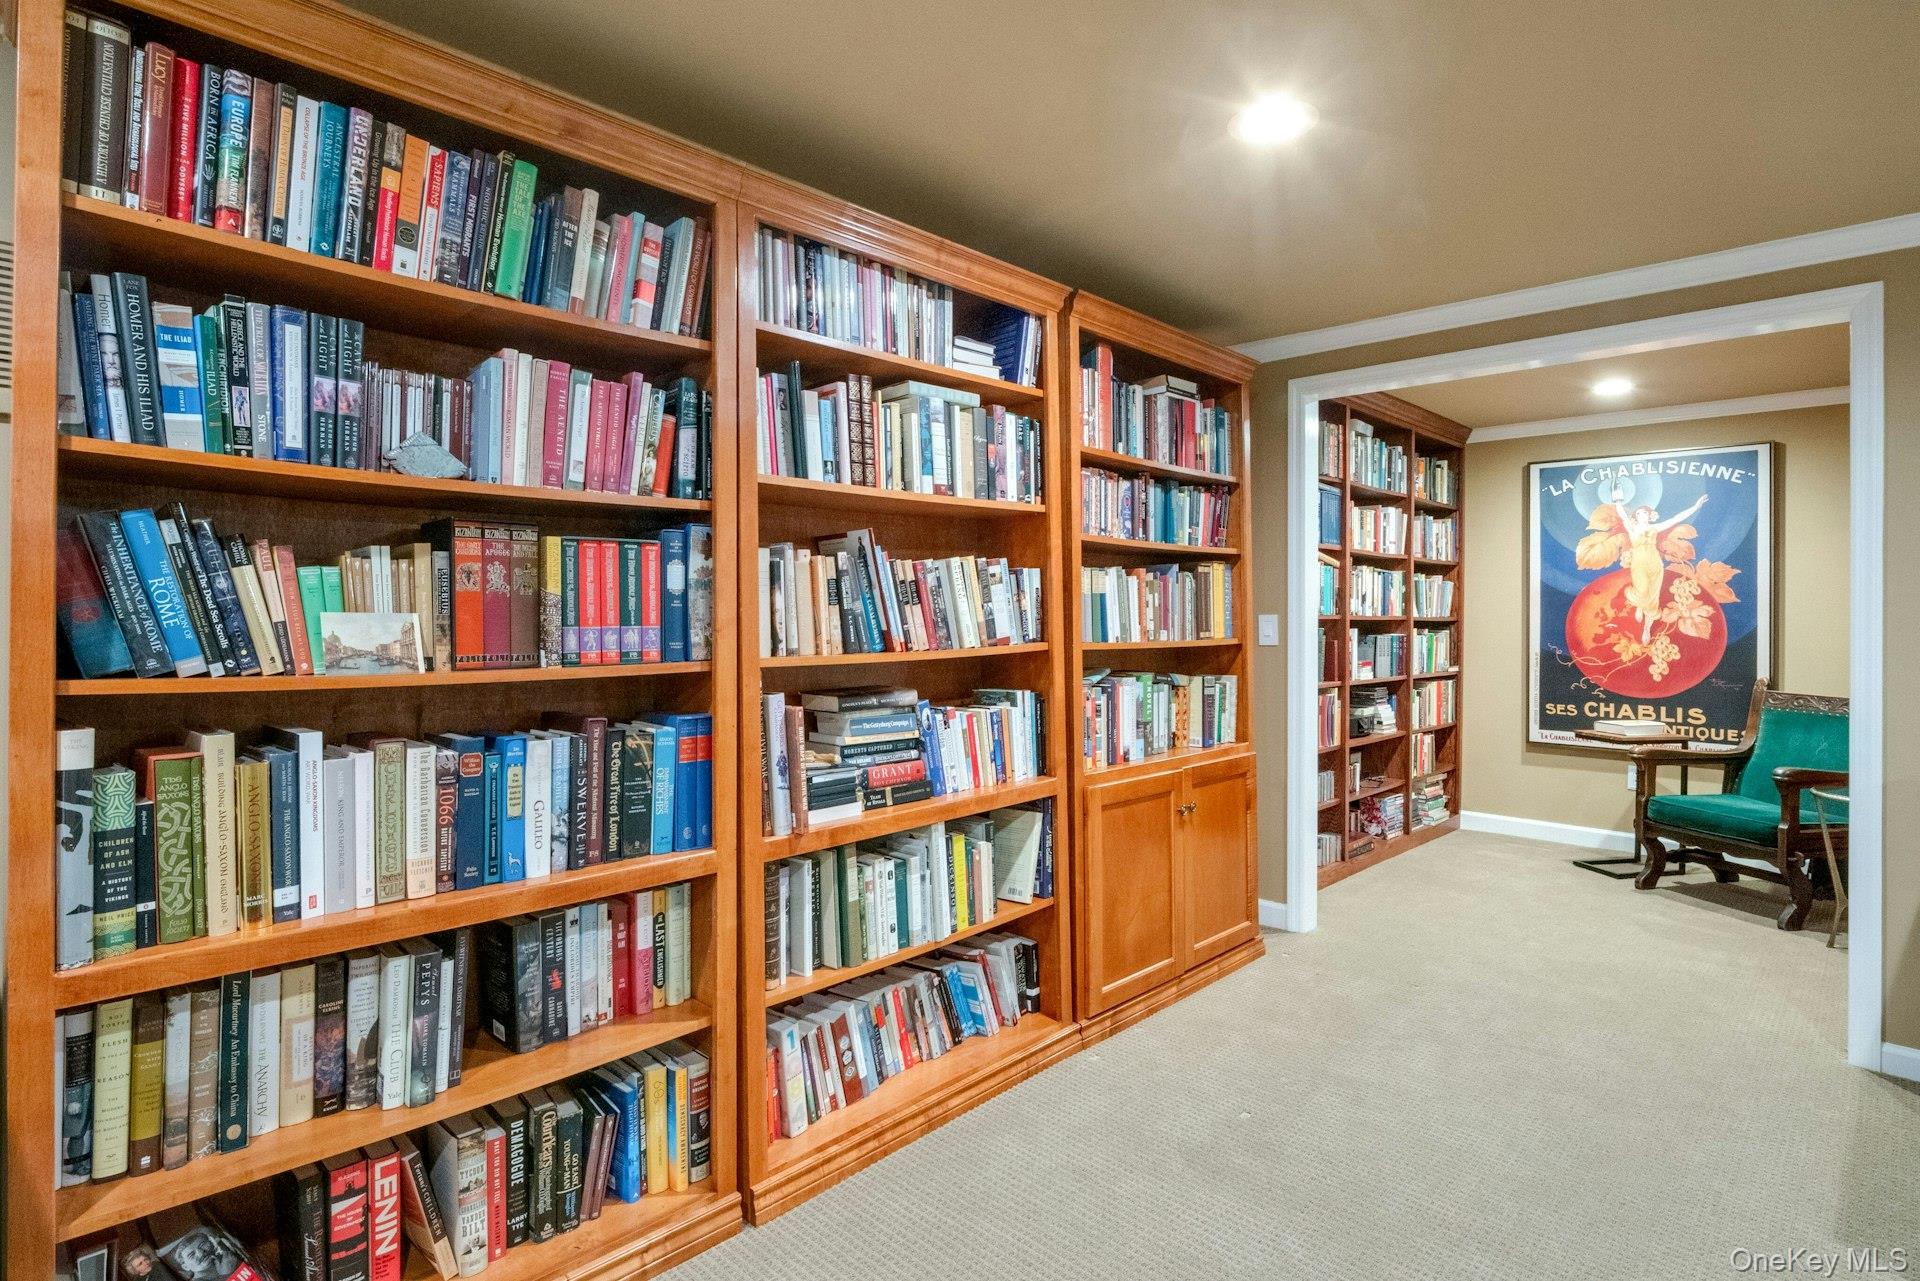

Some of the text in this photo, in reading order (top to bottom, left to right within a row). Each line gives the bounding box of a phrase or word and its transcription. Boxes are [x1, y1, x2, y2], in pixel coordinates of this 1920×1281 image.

[101, 42, 114, 95] CIVILISATION
[99, 96, 111, 130] CHINESE
[205, 72, 221, 161] BORN IN AFRICA
[229, 100, 244, 148] EUROPE
[303, 107, 311, 132] COLLAPSE
[100, 130, 109, 141] OF
[180, 124, 189, 155] MILLION
[322, 119, 343, 177] ANCESTRAL JOURNEYS
[97, 143, 109, 177] HISTORY
[370, 158, 379, 167] Up
[228, 168, 239, 206] FLANNERY
[370, 175, 378, 186] the
[430, 162, 443, 207] SAPIENS
[366, 198, 375, 211] Age
[462, 194, 477, 257] FIRST MIGRANTS
[490, 212, 505, 271] Human Evolution
[97, 293, 112, 329] Homer
[160, 334, 192, 343] THE ILIAD
[319, 334, 328, 371] LIGHT
[127, 294, 154, 431] HOMER AND HIS ILIAD
[342, 339, 352, 375] LIGHT
[94, 382, 102, 397] SEA
[206, 370, 216, 396] ILIAD
[257, 414, 266, 443] STONE
[343, 420, 351, 451] HERMAN
[555, 388, 566, 456] THE AENEID
[648, 393, 663, 442] CATULLUS
[231, 541, 241, 564] CAHILL
[259, 541, 272, 571] PAUL
[108, 585, 125, 619] WICKHAM
[113, 535, 163, 653] INHERITANCE ROME
[148, 578, 180, 629] ROME
[159, 560, 193, 640] THE RESTORATION OF
[441, 568, 449, 614] EUSEBIUS
[198, 572, 228, 649] The Dead Sea Scrolls
[1545, 701, 1708, 725] SES CHABLIS
[872, 764, 912, 779] GRANT
[439, 786, 455, 825] 1066
[609, 741, 622, 852] The Great Fire of London
[656, 767, 665, 815] OF RICHES
[533, 800, 544, 849] GALILEO
[577, 777, 587, 842] SWERVE
[98, 837, 134, 848] CHILDREN
[104, 849, 130, 858] OF ASH
[284, 824, 292, 869] ANGLO-SAXON
[100, 859, 133, 871] AND ELM
[656, 923, 665, 948] LAST
[232, 980, 241, 997] Lord
[421, 962, 431, 1006] PEPYS
[229, 998, 241, 1036] Macartney
[102, 1038, 128, 1048] FLESH
[230, 1039, 238, 1049] An
[390, 1021, 402, 1083] THE CLUB
[229, 1051, 239, 1084] Embassy
[230, 1094, 238, 1117] China
[255, 1064, 269, 1117] ANARCHY
[510, 1119, 524, 1187] DEMAGOGUE
[572, 1154, 579, 1165] GO
[375, 1157, 398, 1257] LENIN
[424, 1193, 442, 1236] CHILDREN
[507, 1213, 527, 1226] LARRY
[462, 1219, 485, 1237] BILT
[512, 1221, 524, 1231] TYE
